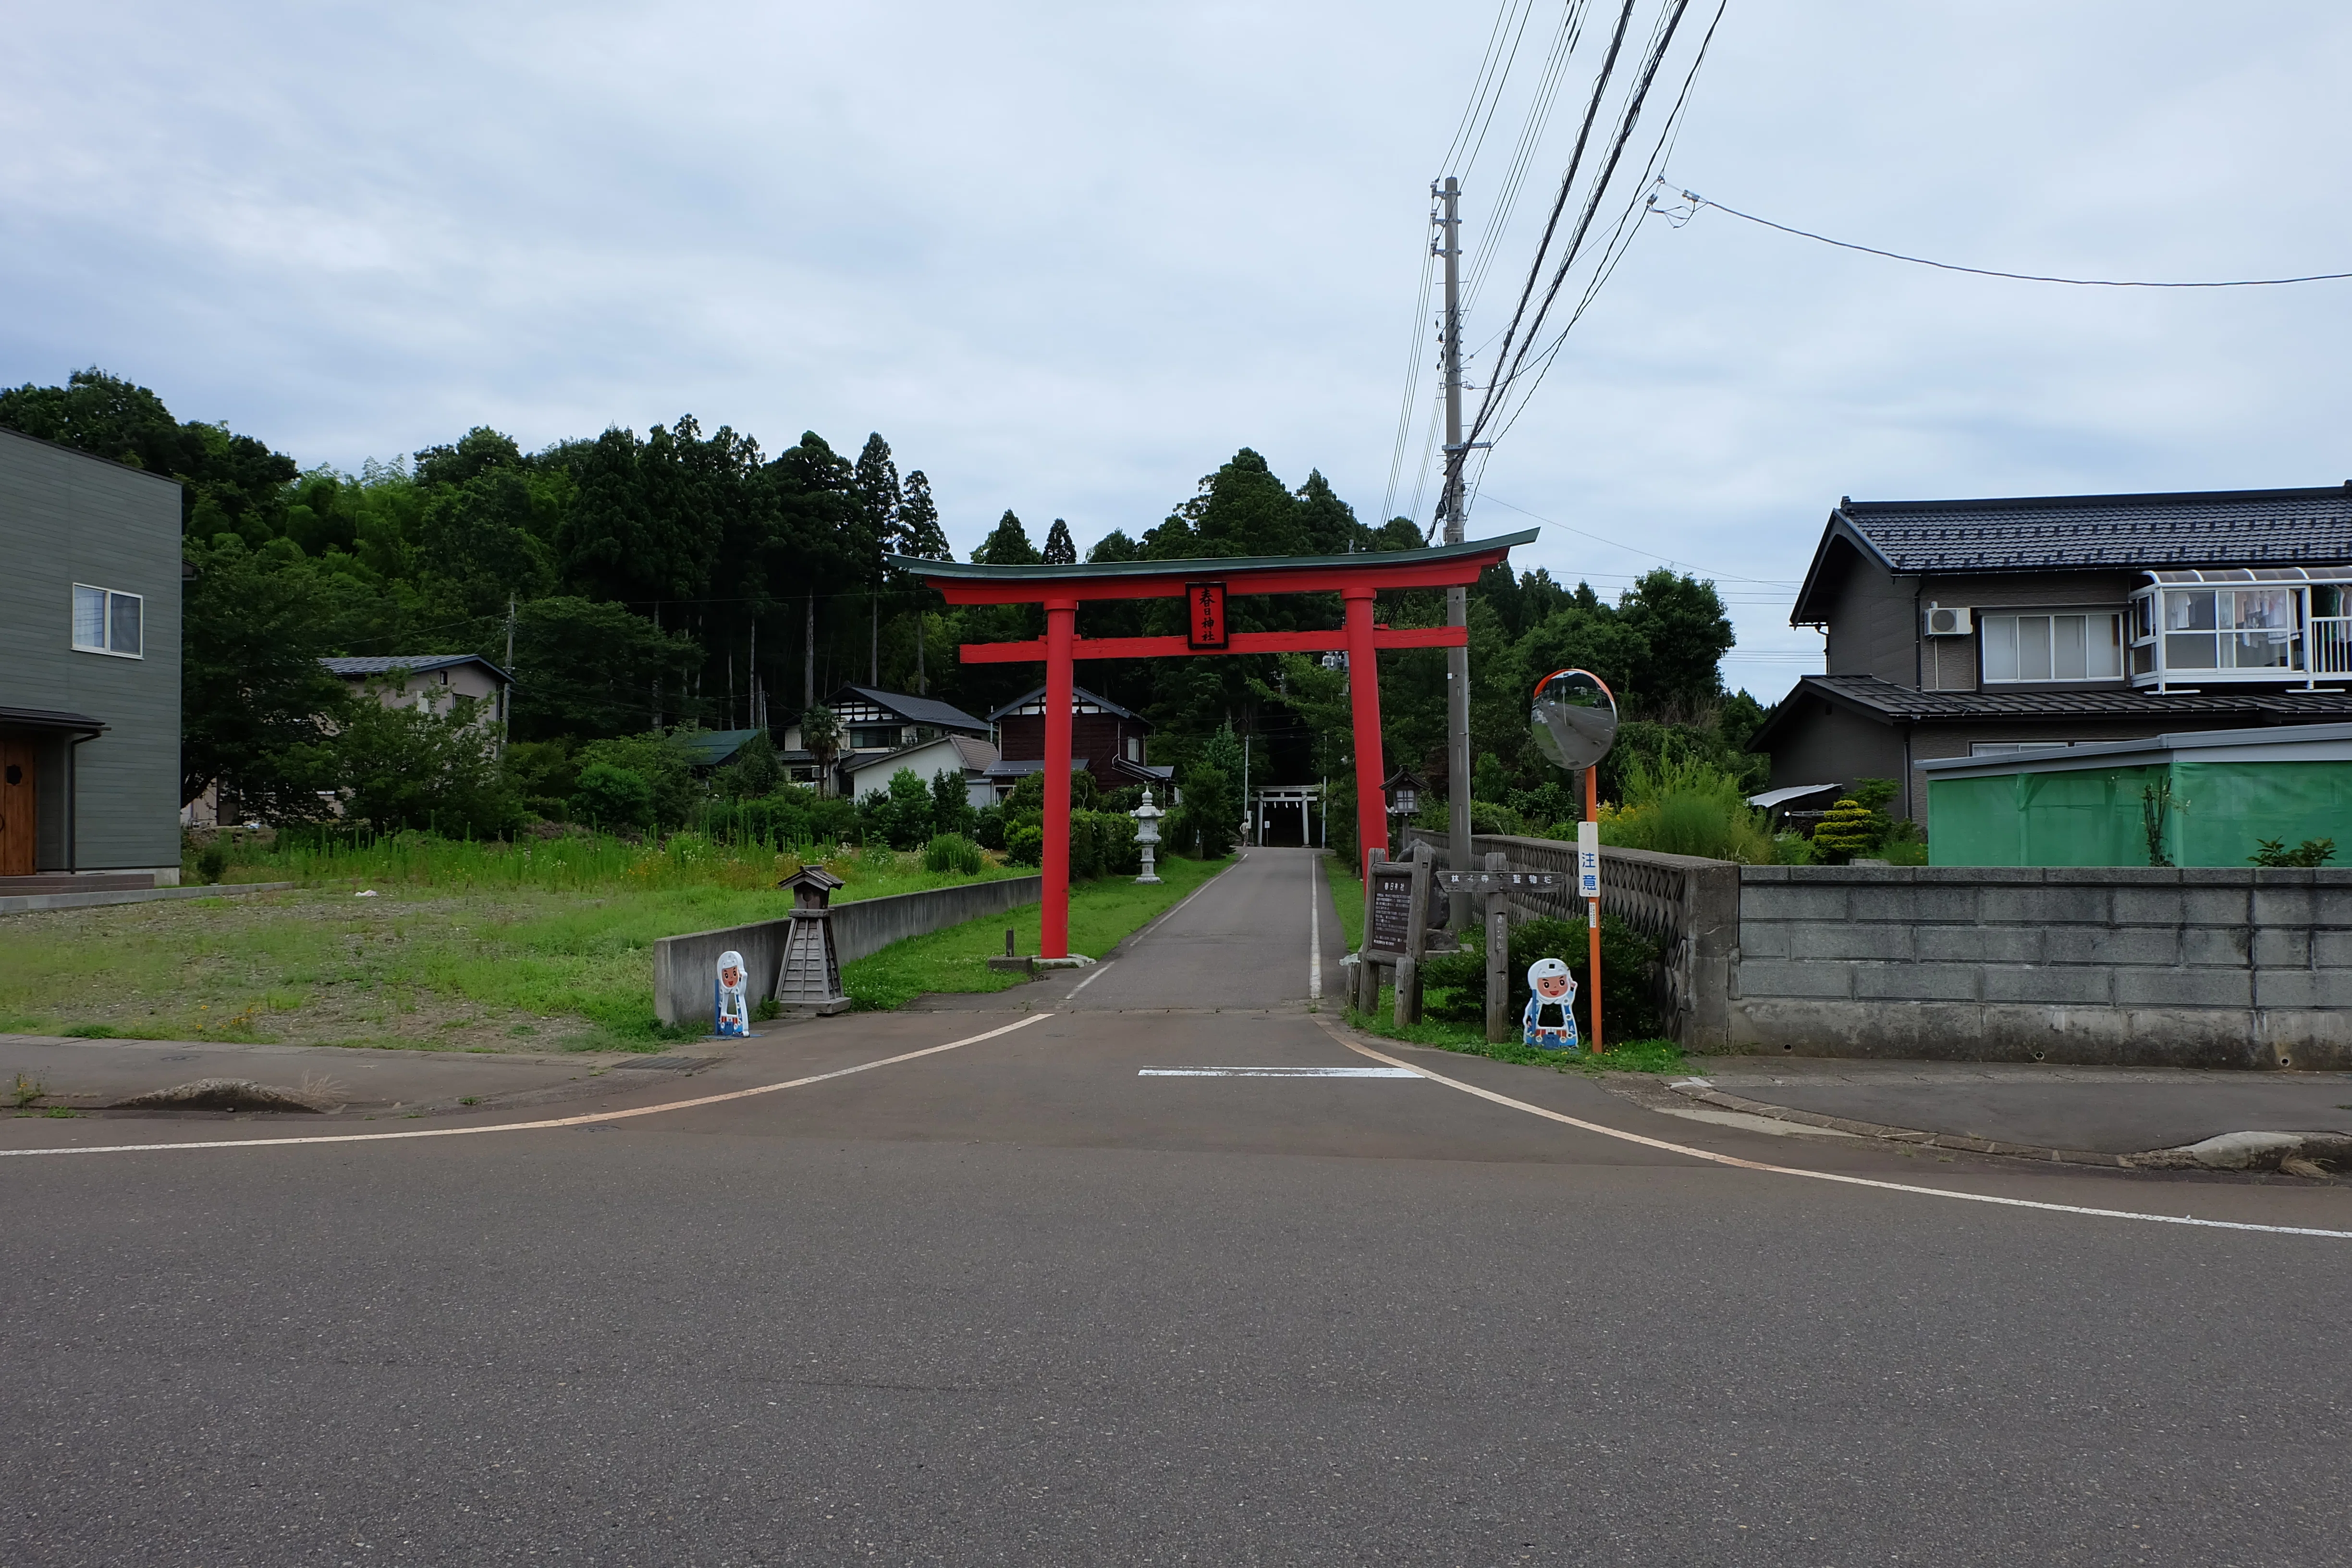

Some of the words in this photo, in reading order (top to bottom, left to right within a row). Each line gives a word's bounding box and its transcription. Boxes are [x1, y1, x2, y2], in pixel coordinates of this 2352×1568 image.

[1199, 587, 1216, 642] 春日神社
[1582, 852, 1596, 890] 注意
